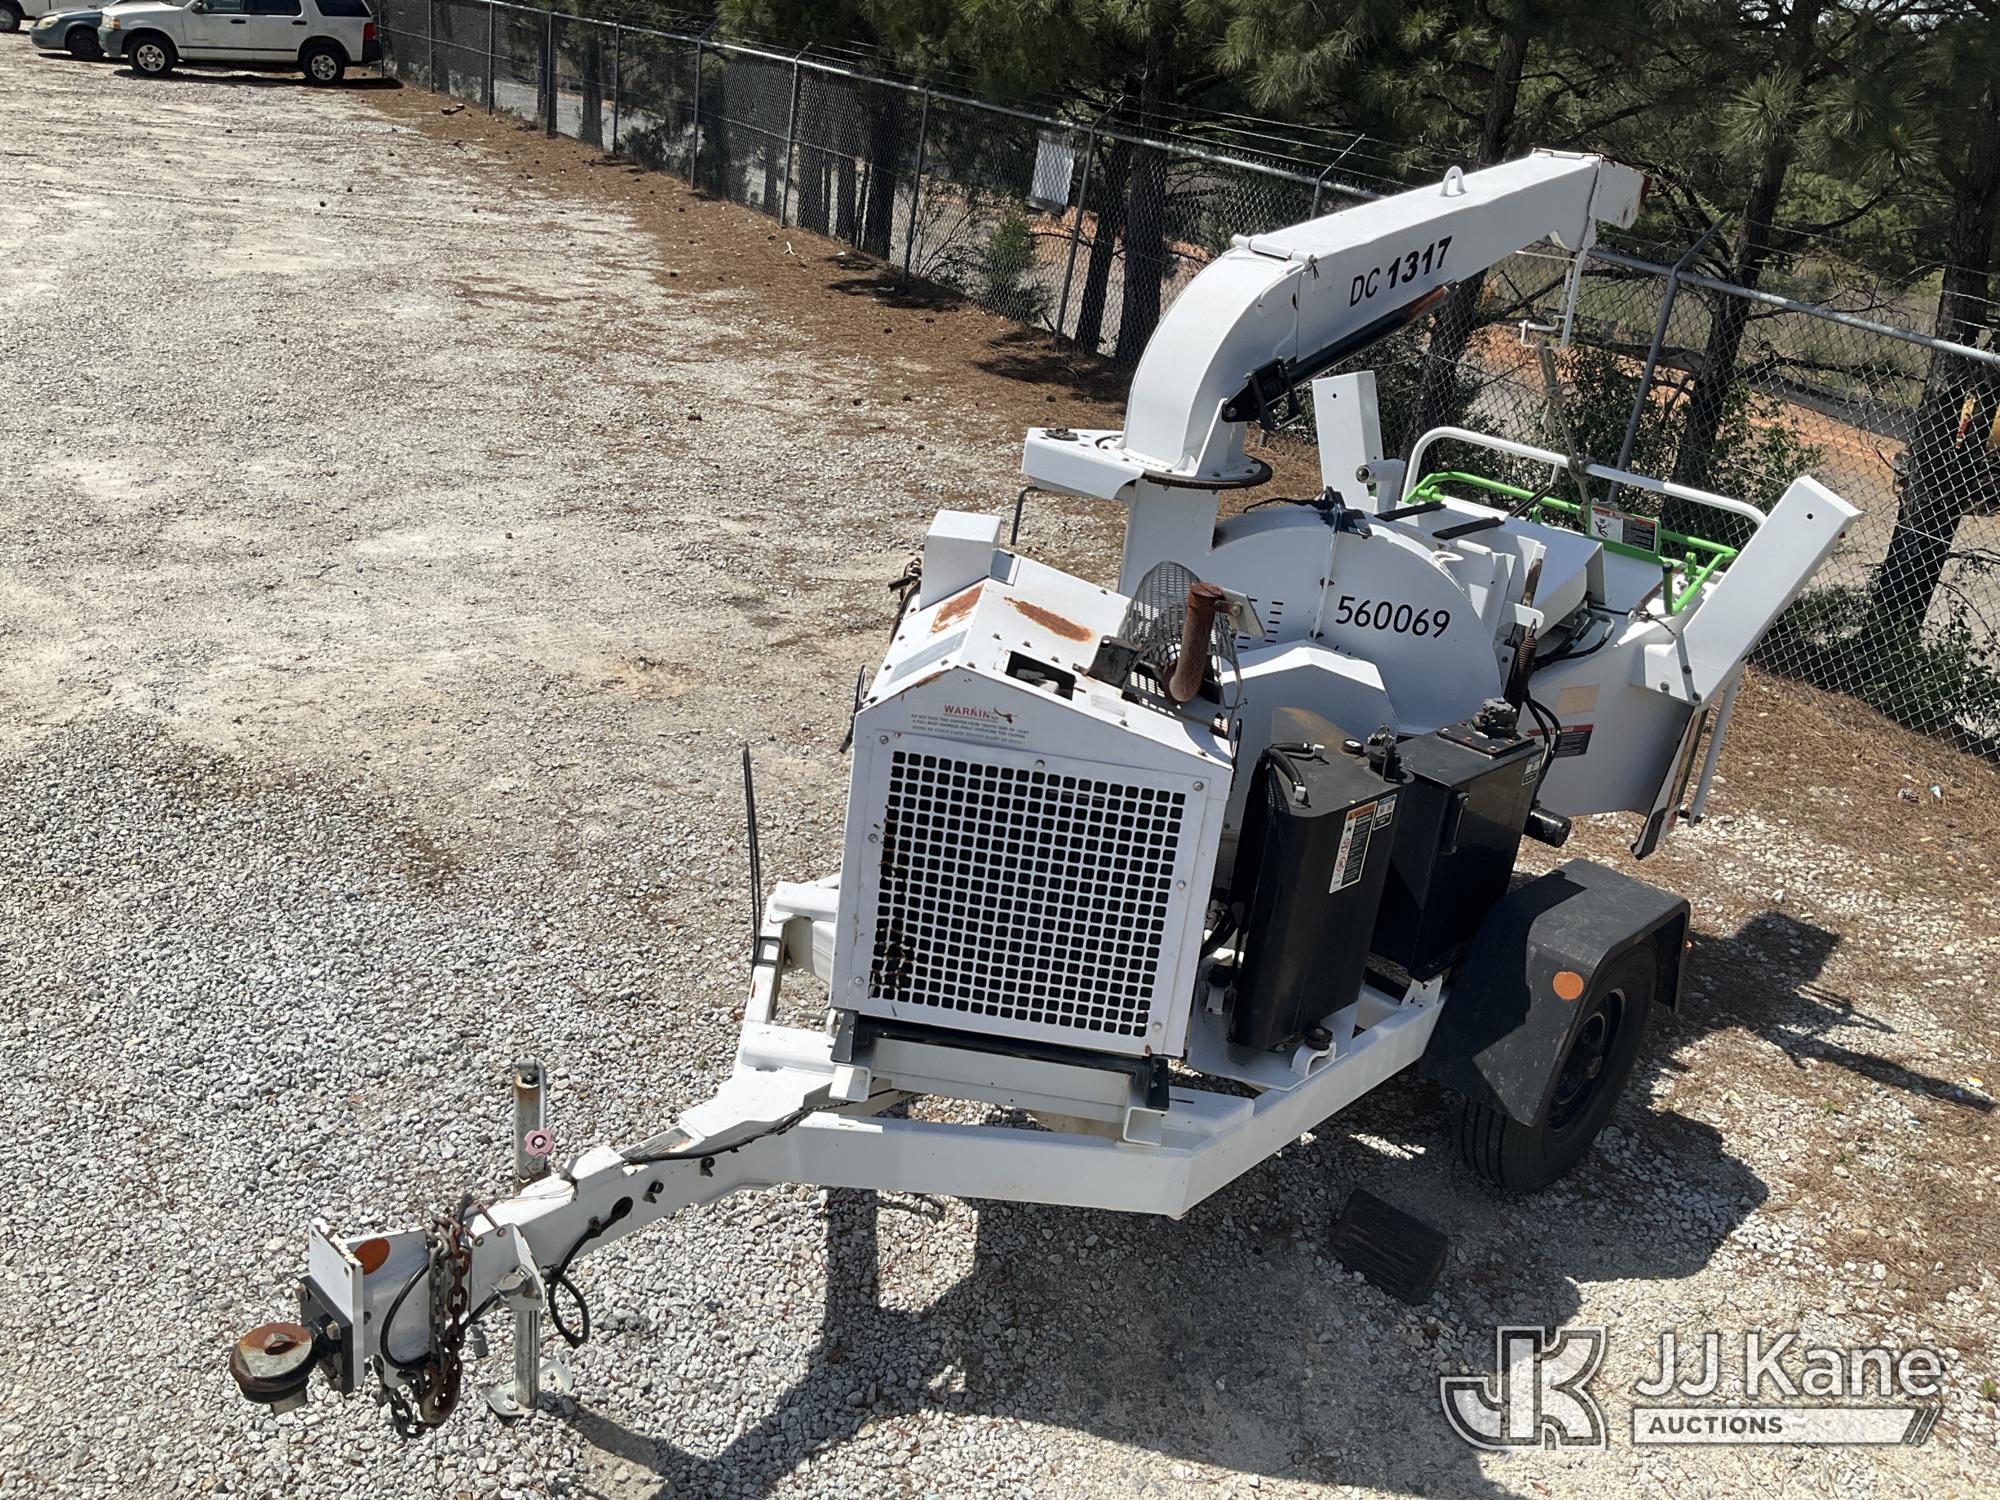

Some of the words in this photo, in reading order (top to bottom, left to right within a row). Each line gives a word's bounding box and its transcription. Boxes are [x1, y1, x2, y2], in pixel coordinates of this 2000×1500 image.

[1350, 267, 1380, 307] DC
[1387, 235, 1453, 290] 1317
[1335, 595, 1451, 639] 560069
